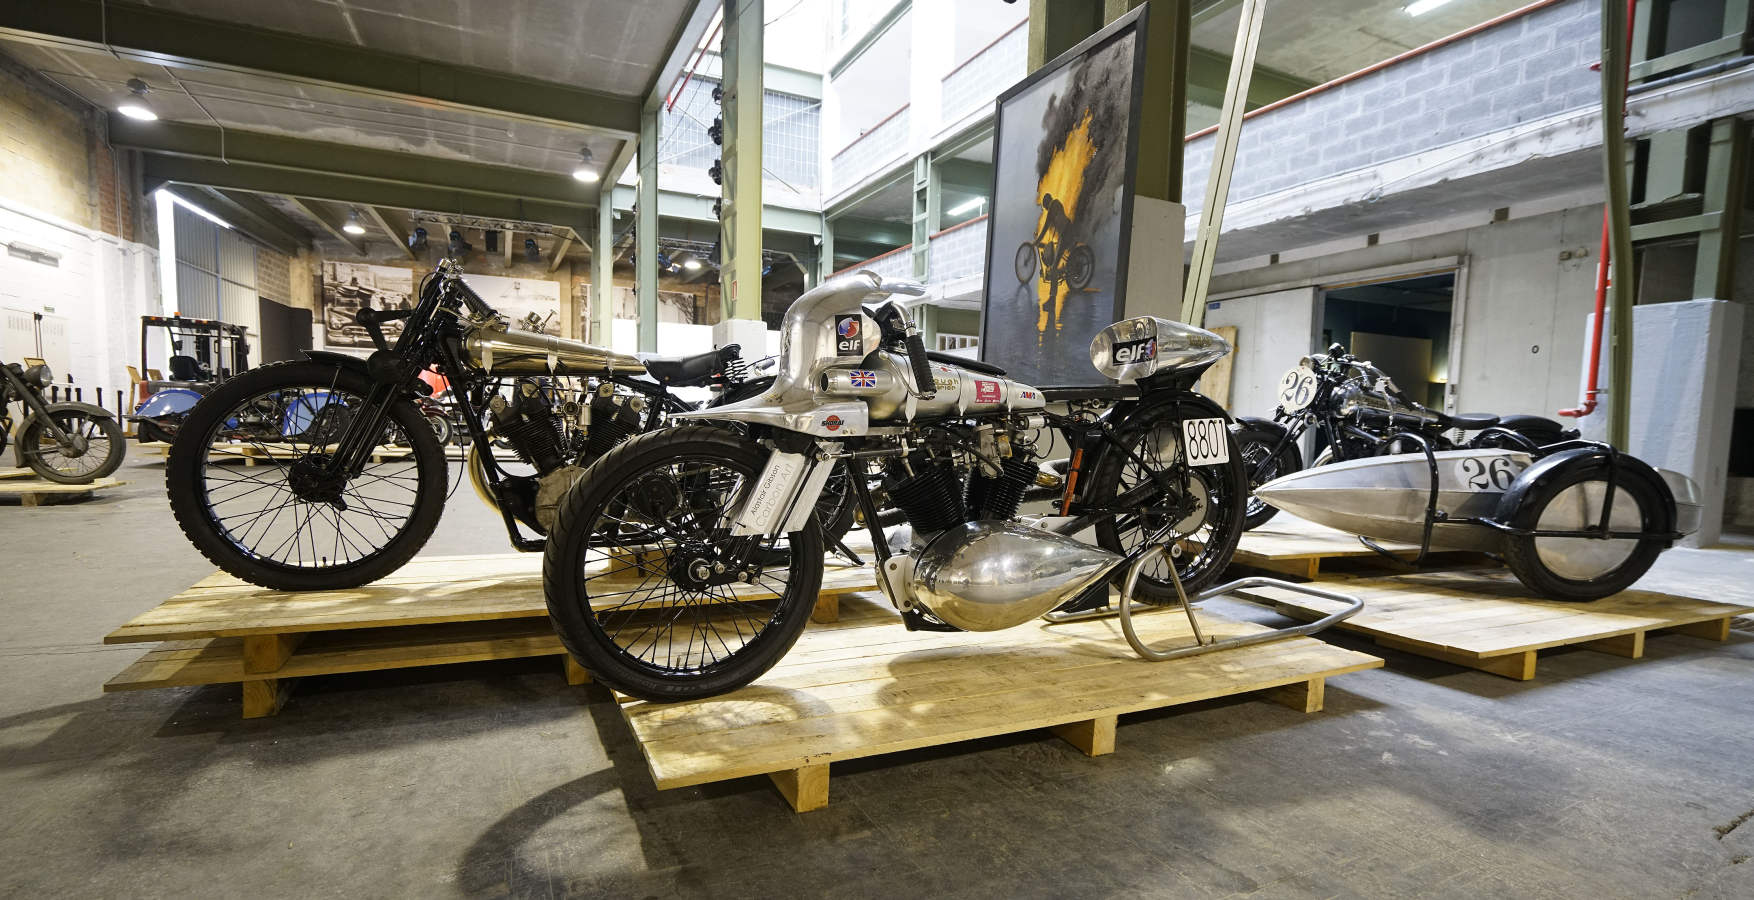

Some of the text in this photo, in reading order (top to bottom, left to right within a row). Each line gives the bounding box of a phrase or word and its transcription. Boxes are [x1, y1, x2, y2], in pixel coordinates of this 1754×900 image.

[838, 339, 860, 351] elf
[1116, 345, 1146, 362] elf
[1282, 371, 1314, 405] 26
[1188, 420, 1228, 459] 8801
[764, 465, 781, 490] Gibson
[1463, 457, 1514, 490] 26
[756, 464, 794, 526] Carbon Art
